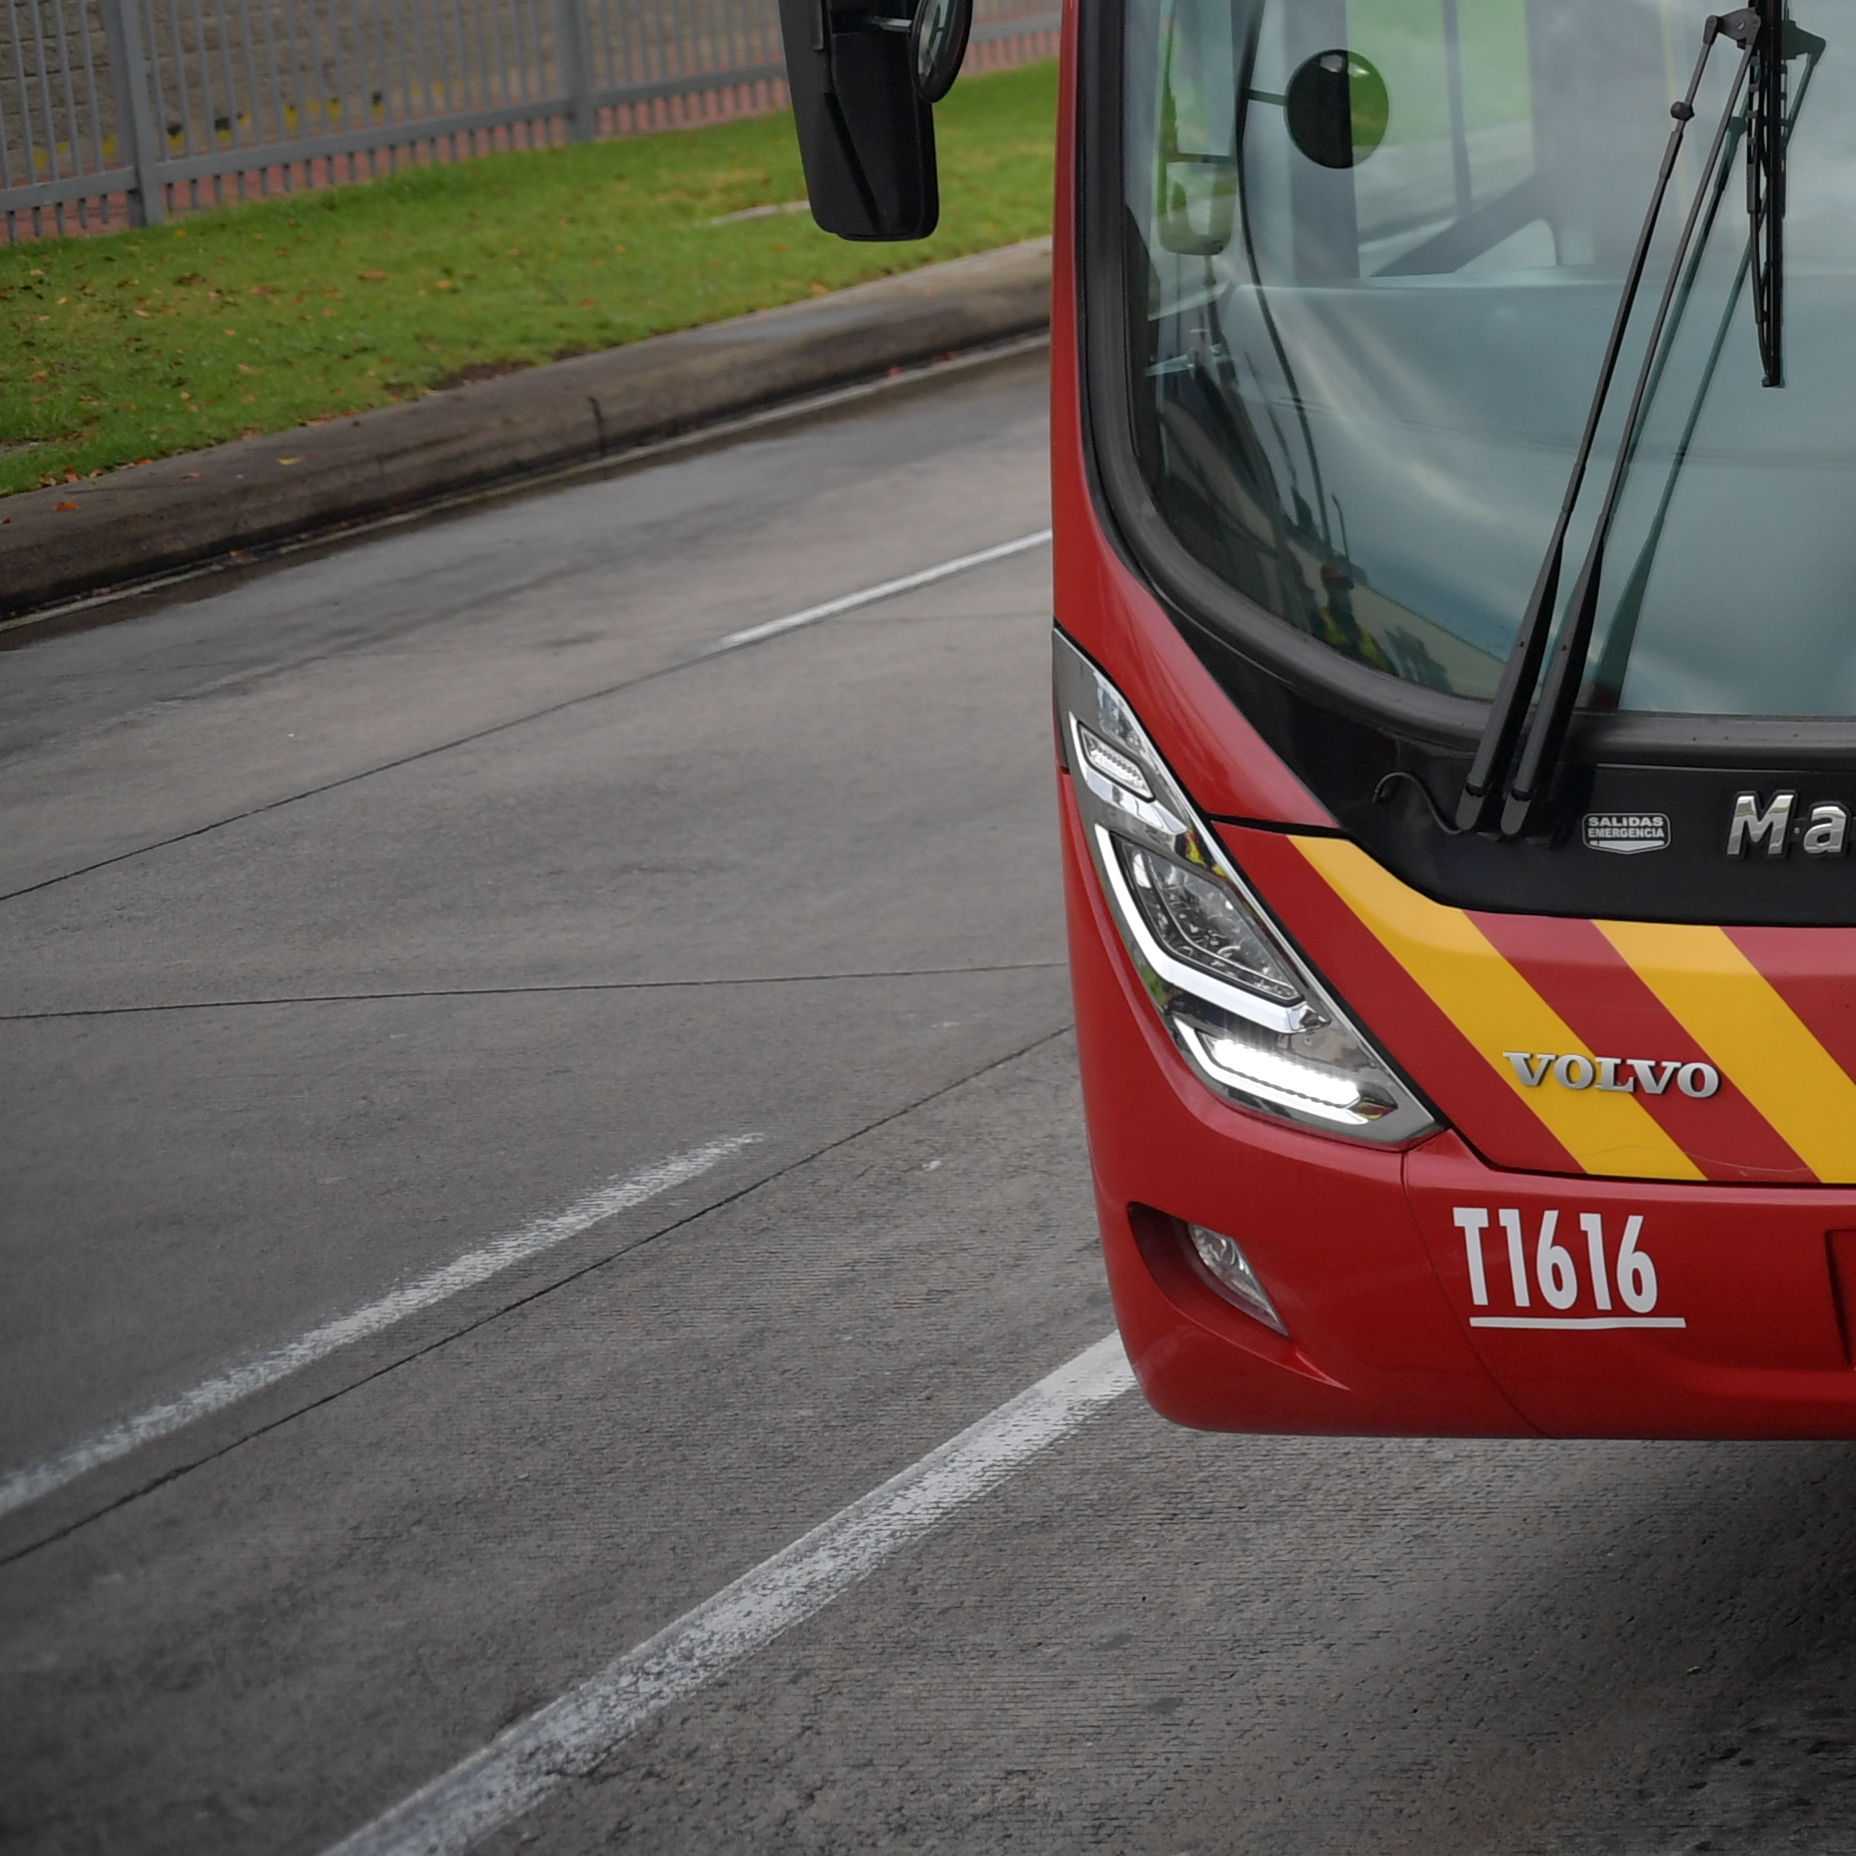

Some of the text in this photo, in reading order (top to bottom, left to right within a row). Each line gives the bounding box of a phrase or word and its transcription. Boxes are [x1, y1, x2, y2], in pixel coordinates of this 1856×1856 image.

[1587, 816, 1665, 827] SALIDAS
[1587, 827, 1665, 838] EMERGENCIA
[1502, 1051, 1720, 1100] VOLVO
[1452, 1206, 1659, 1314] T1616
